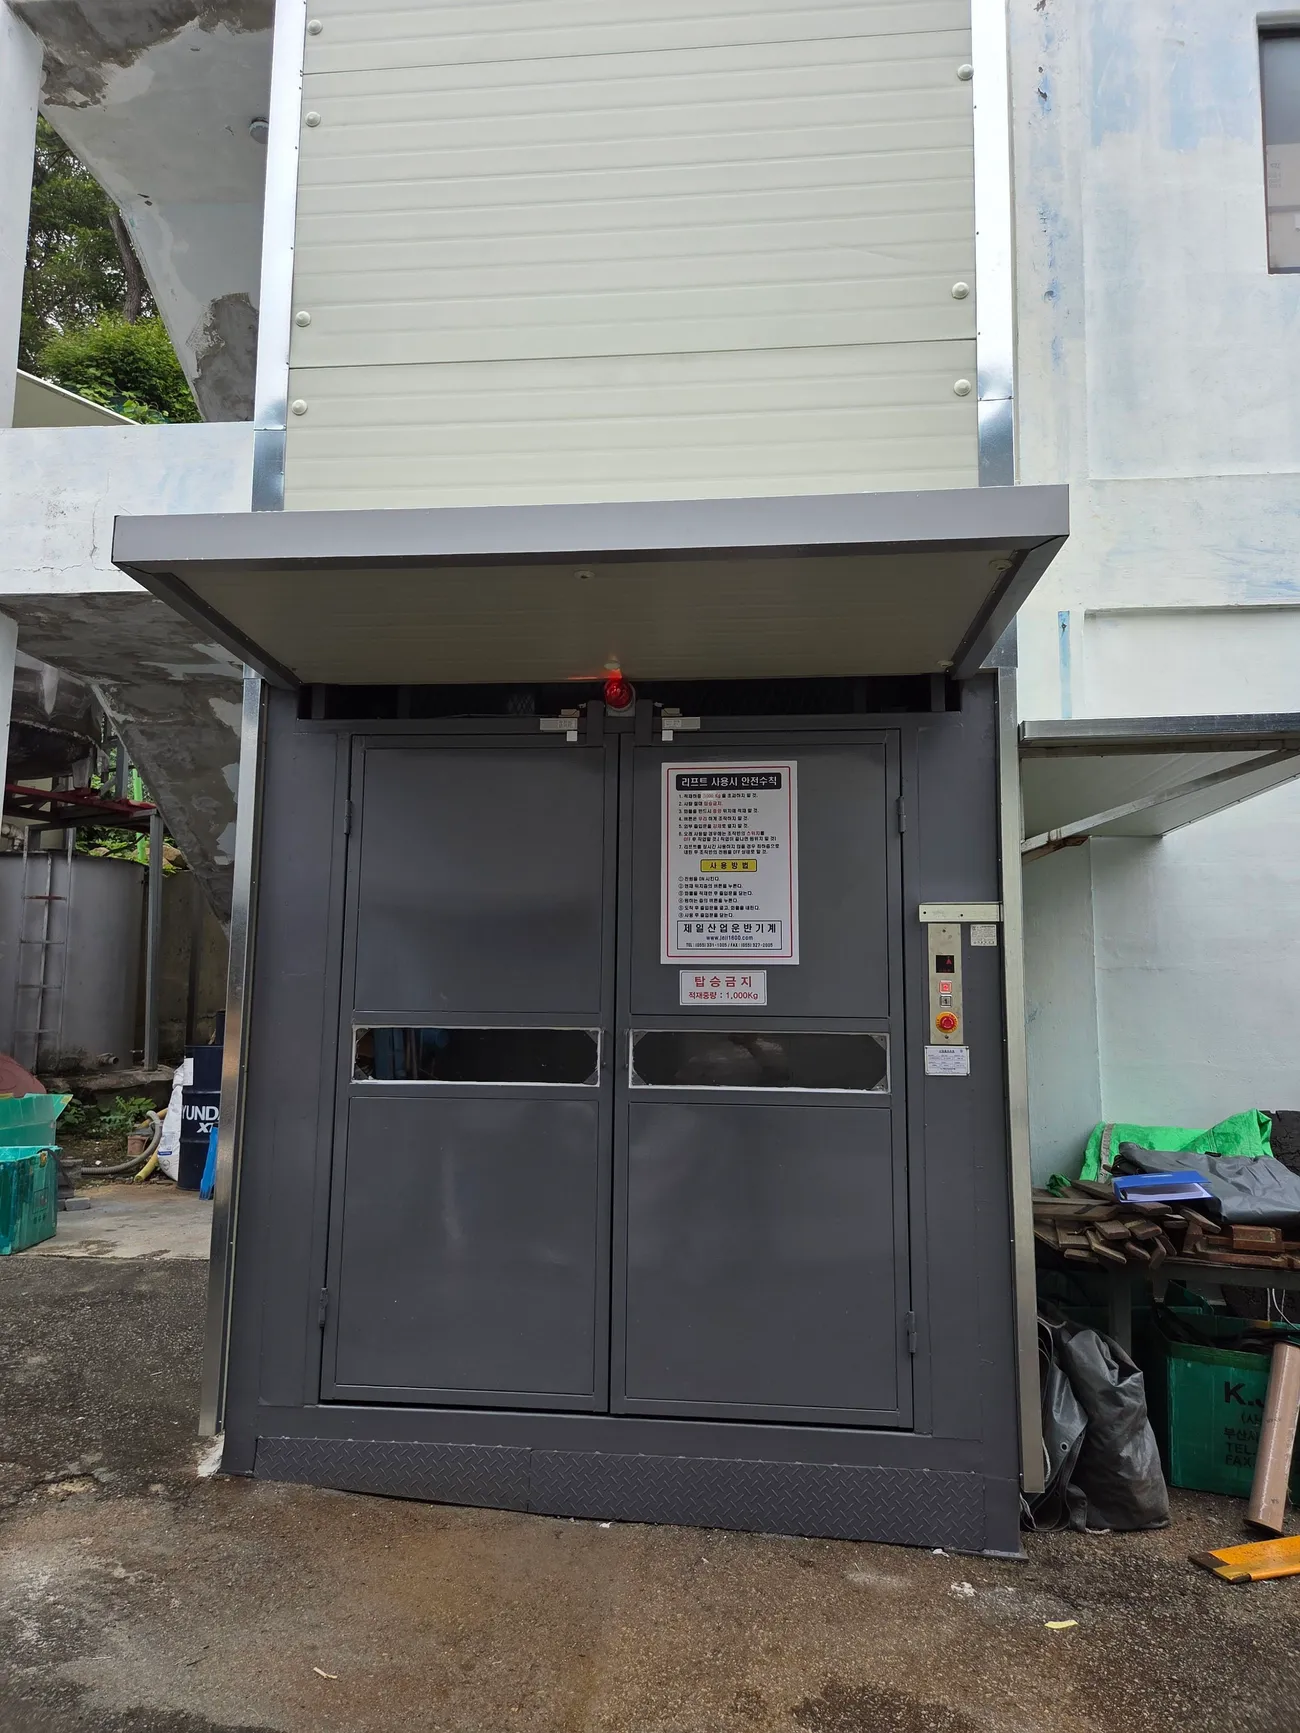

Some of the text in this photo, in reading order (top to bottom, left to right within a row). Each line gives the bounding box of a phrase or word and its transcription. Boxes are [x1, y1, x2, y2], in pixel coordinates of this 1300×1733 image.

[681, 776, 777, 787] 리프트 사용시 안전수칙
[684, 924, 776, 933] 제일산업운반기계
[694, 976, 752, 988] 탑승금지
[182, 1105, 220, 1121] YUND
